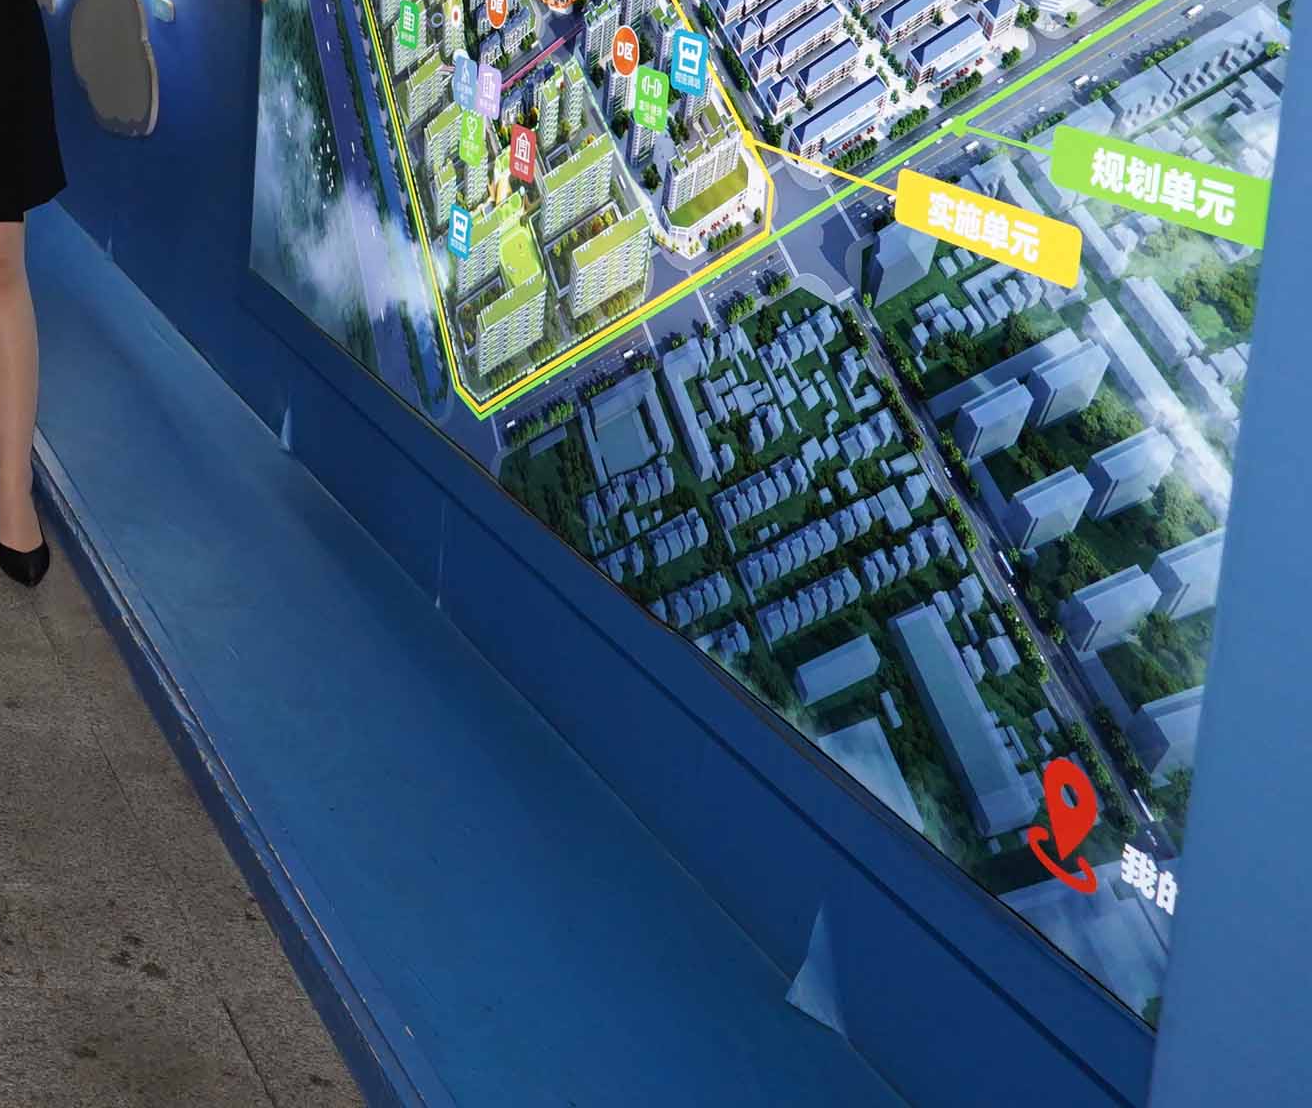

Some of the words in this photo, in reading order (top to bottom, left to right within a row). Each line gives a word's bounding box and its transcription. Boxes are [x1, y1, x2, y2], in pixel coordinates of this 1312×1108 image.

[617, 41, 635, 61] D区
[1089, 147, 1236, 226] 规划单元
[927, 192, 1040, 265] 实施单元
